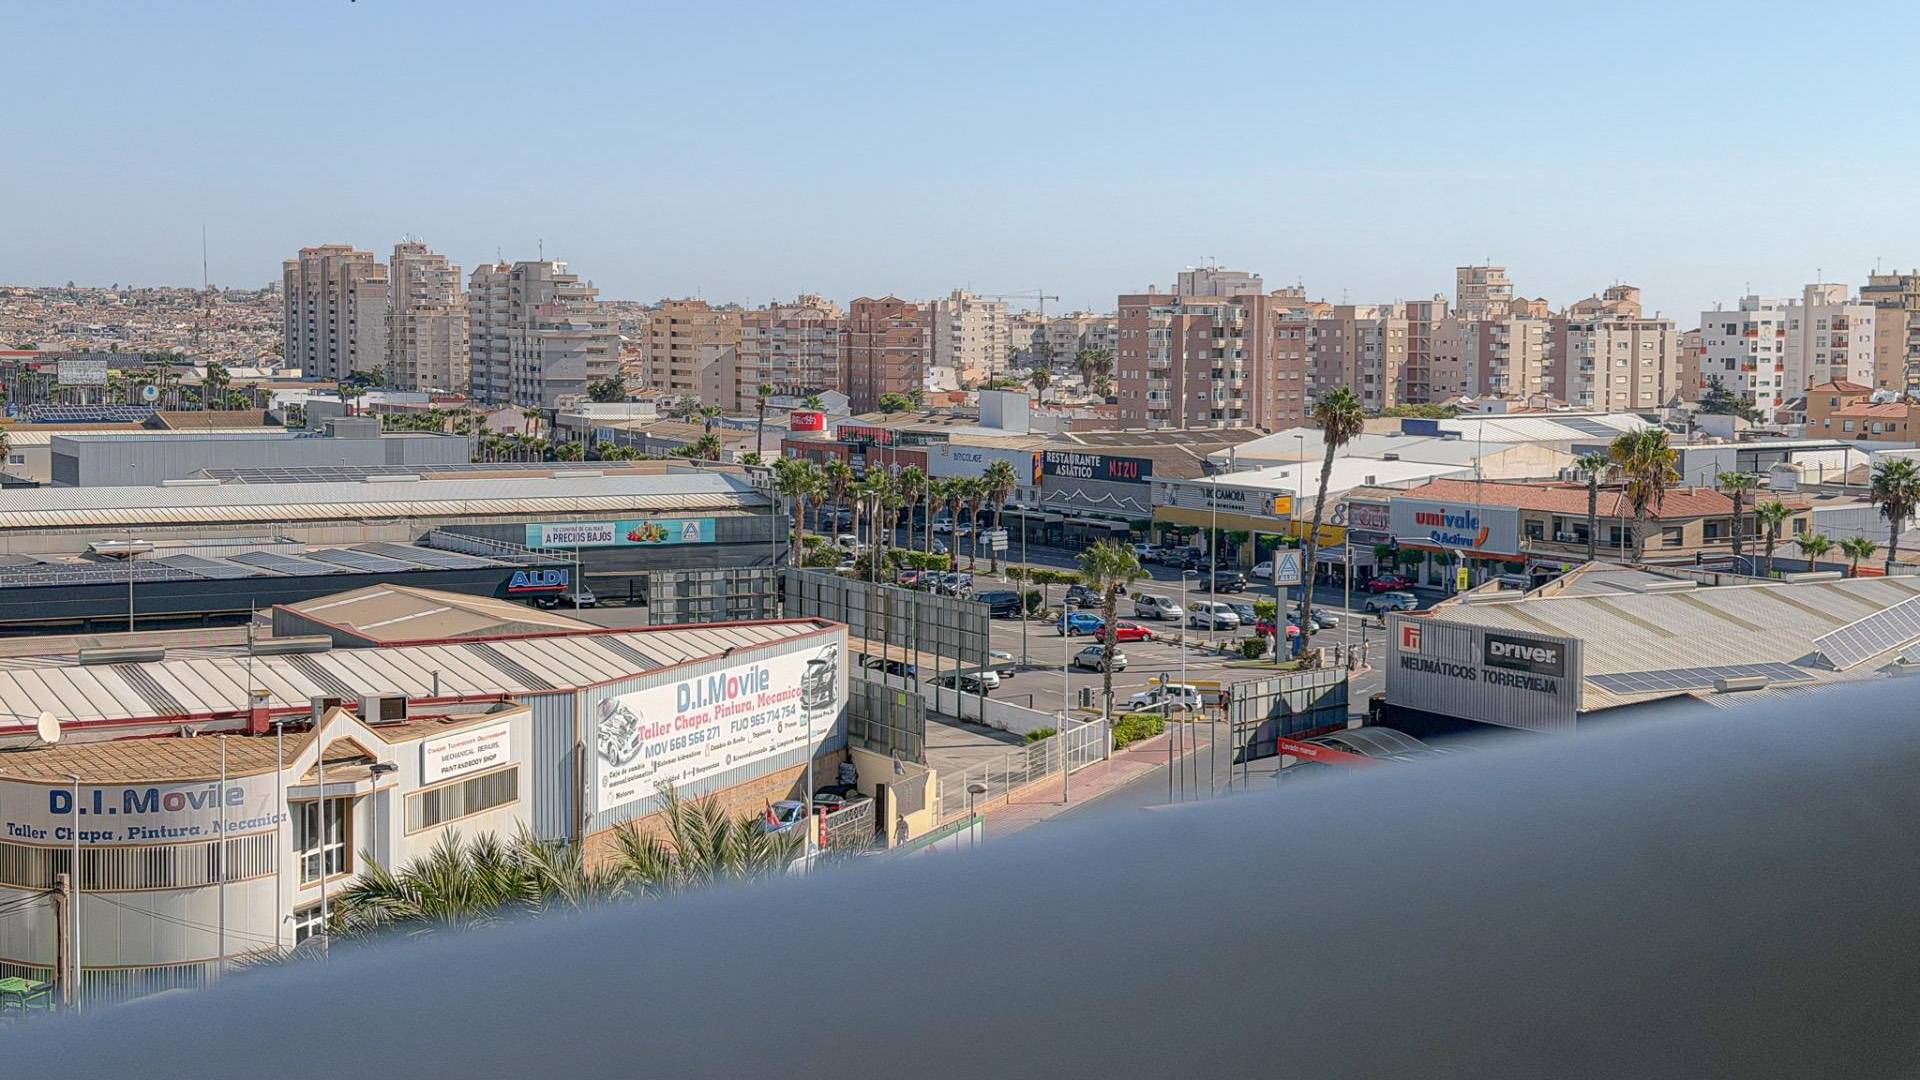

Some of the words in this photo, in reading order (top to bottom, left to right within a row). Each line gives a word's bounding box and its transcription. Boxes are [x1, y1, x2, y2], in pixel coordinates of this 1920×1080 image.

[1046, 452, 1101, 467] RESTAURANTE
[1109, 460, 1137, 478] MIZU
[1416, 508, 1479, 531] umivale
[545, 533, 551, 543] A
[553, 532, 586, 543] PRECIOS
[587, 531, 612, 541] BAJOS
[509, 569, 569, 587] ALDI
[1401, 656, 1477, 681] NEUMÁTICOS
[1481, 669, 1558, 694] TORREVIEJA
[677, 665, 769, 714] D.I.Movile
[638, 720, 672, 741] Taller
[674, 711, 712, 731] Chapa,
[714, 700, 755, 720] Pintura,
[757, 685, 803, 707] Mecanica
[645, 739, 668, 758] MOV
[669, 735, 687, 751] 668
[706, 725, 721, 742] 271
[730, 719, 749, 733] FIJO
[750, 713, 766, 728] 965
[766, 708, 781, 723] 714
[781, 704, 796, 720] 754
[441, 764, 457, 774] PAINT
[483, 753, 497, 763] SHOP
[49, 784, 244, 815] D.I.Movile
[6, 822, 47, 840] Taller
[212, 812, 287, 834] Mecanica
